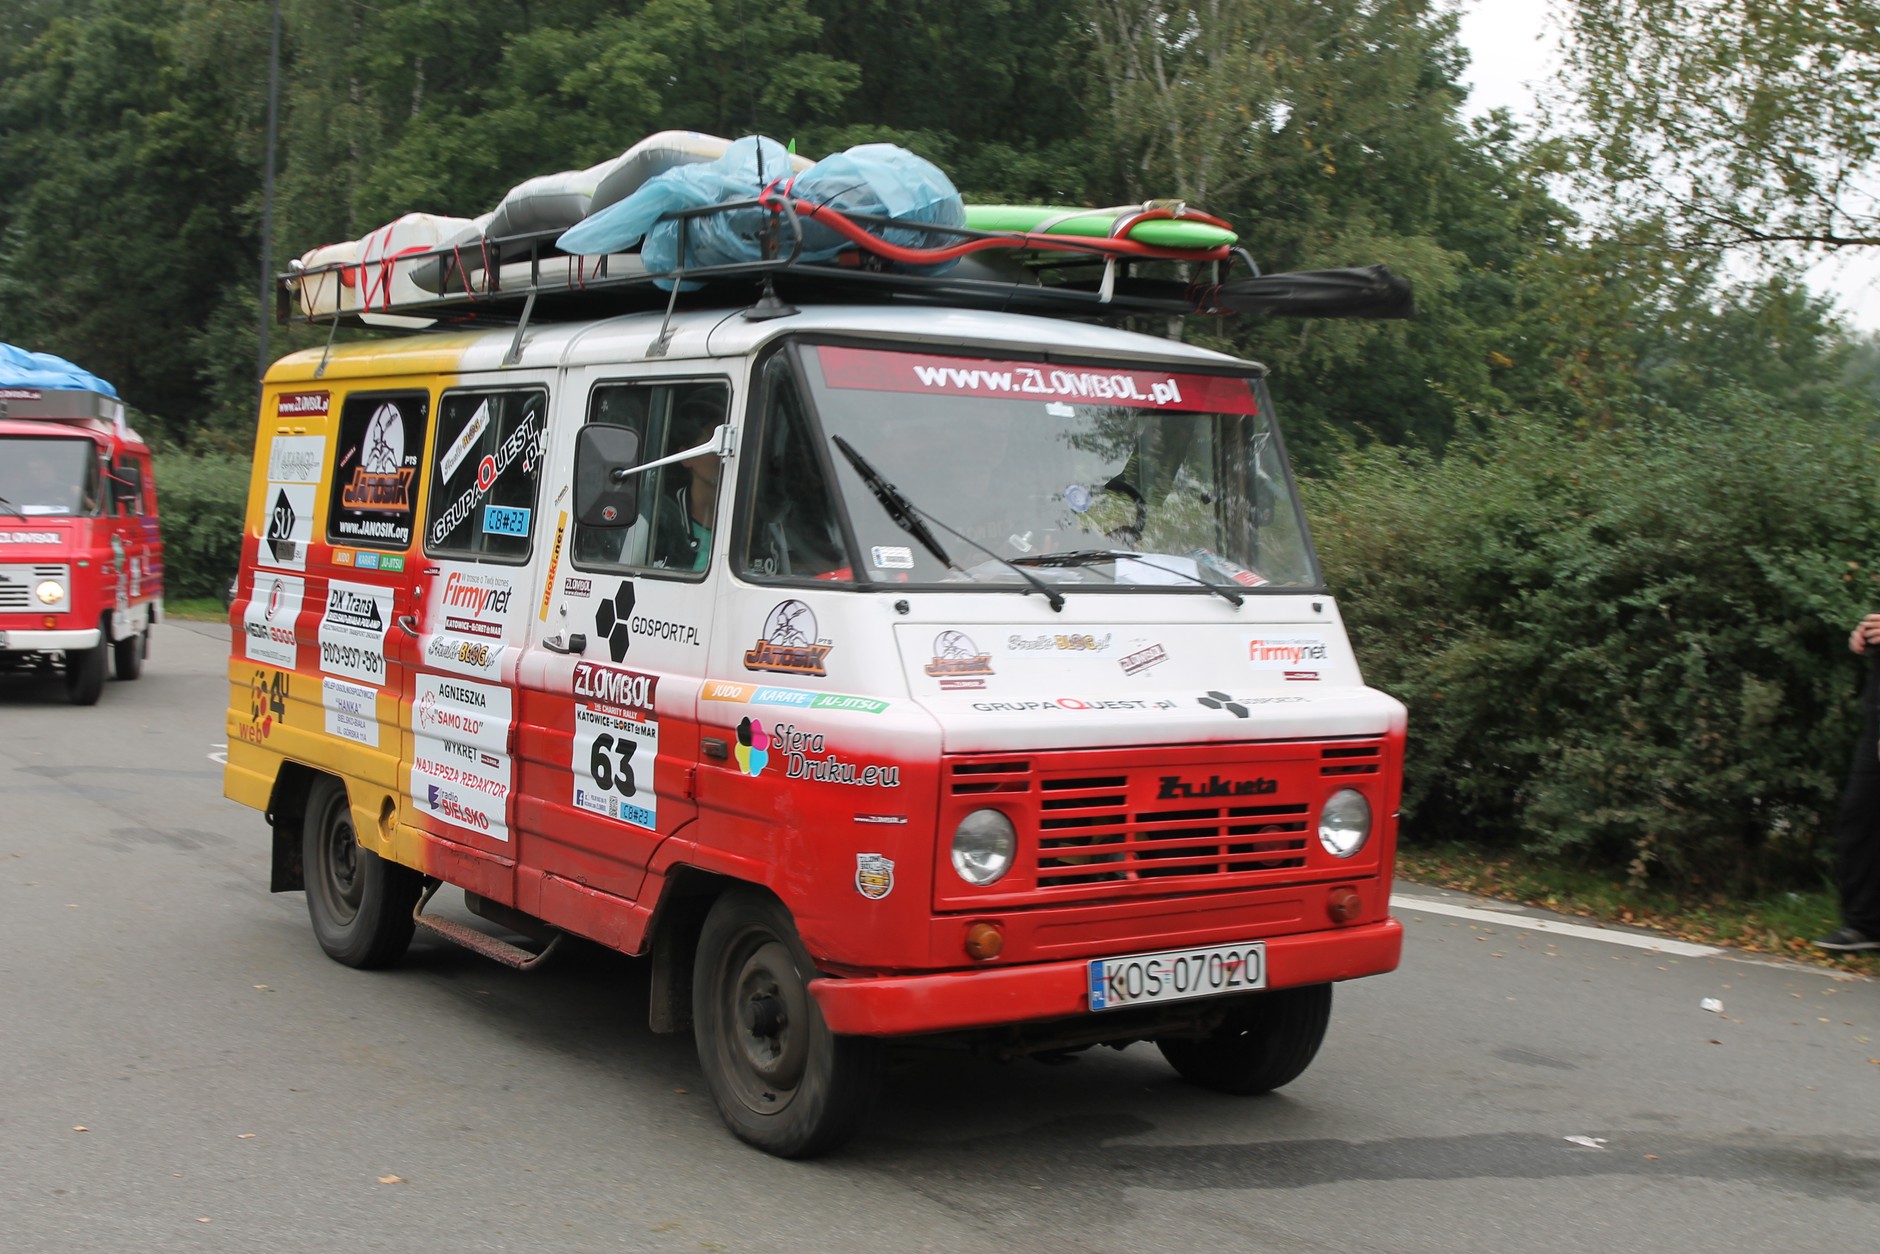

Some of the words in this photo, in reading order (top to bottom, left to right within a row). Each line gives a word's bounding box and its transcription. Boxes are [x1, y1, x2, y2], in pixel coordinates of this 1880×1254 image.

[913, 366, 1182, 404] www.ZLOMBOL.pl
[404, 455, 417, 465] PTS
[271, 507, 292, 540] SU
[339, 520, 409, 543] www.JANOSIK.org
[488, 509, 525, 533] CB#23
[336, 551, 350, 563] JUDO
[358, 554, 377, 566] KARATE
[381, 556, 403, 569] JU-JITSU
[330, 589, 345, 609] DK
[346, 592, 371, 614] Trans
[631, 615, 700, 646] GDSPORT.PL
[438, 683, 487, 708] AGNIESZKA
[574, 663, 655, 711] ZLOMBOL
[712, 684, 743, 699] JUDO
[758, 688, 809, 704] KARATE
[602, 705, 623, 717] CHARITY
[622, 709, 638, 720] RALLY
[819, 696, 883, 711] JU-JITSU
[640, 726, 657, 738] MAR
[773, 723, 825, 755] Sfera
[442, 738, 478, 763] WYKRĘT
[590, 732, 638, 798] 63
[786, 752, 901, 787] Druku.eu
[415, 756, 460, 781] NAJLEPSZA
[461, 771, 507, 799] REDAKTOR
[441, 790, 459, 803] radio
[442, 799, 490, 831] BIELSKO
[623, 804, 649, 825] CB#23
[1107, 959, 1163, 1002] KOS
[1173, 949, 1260, 993] 07020
